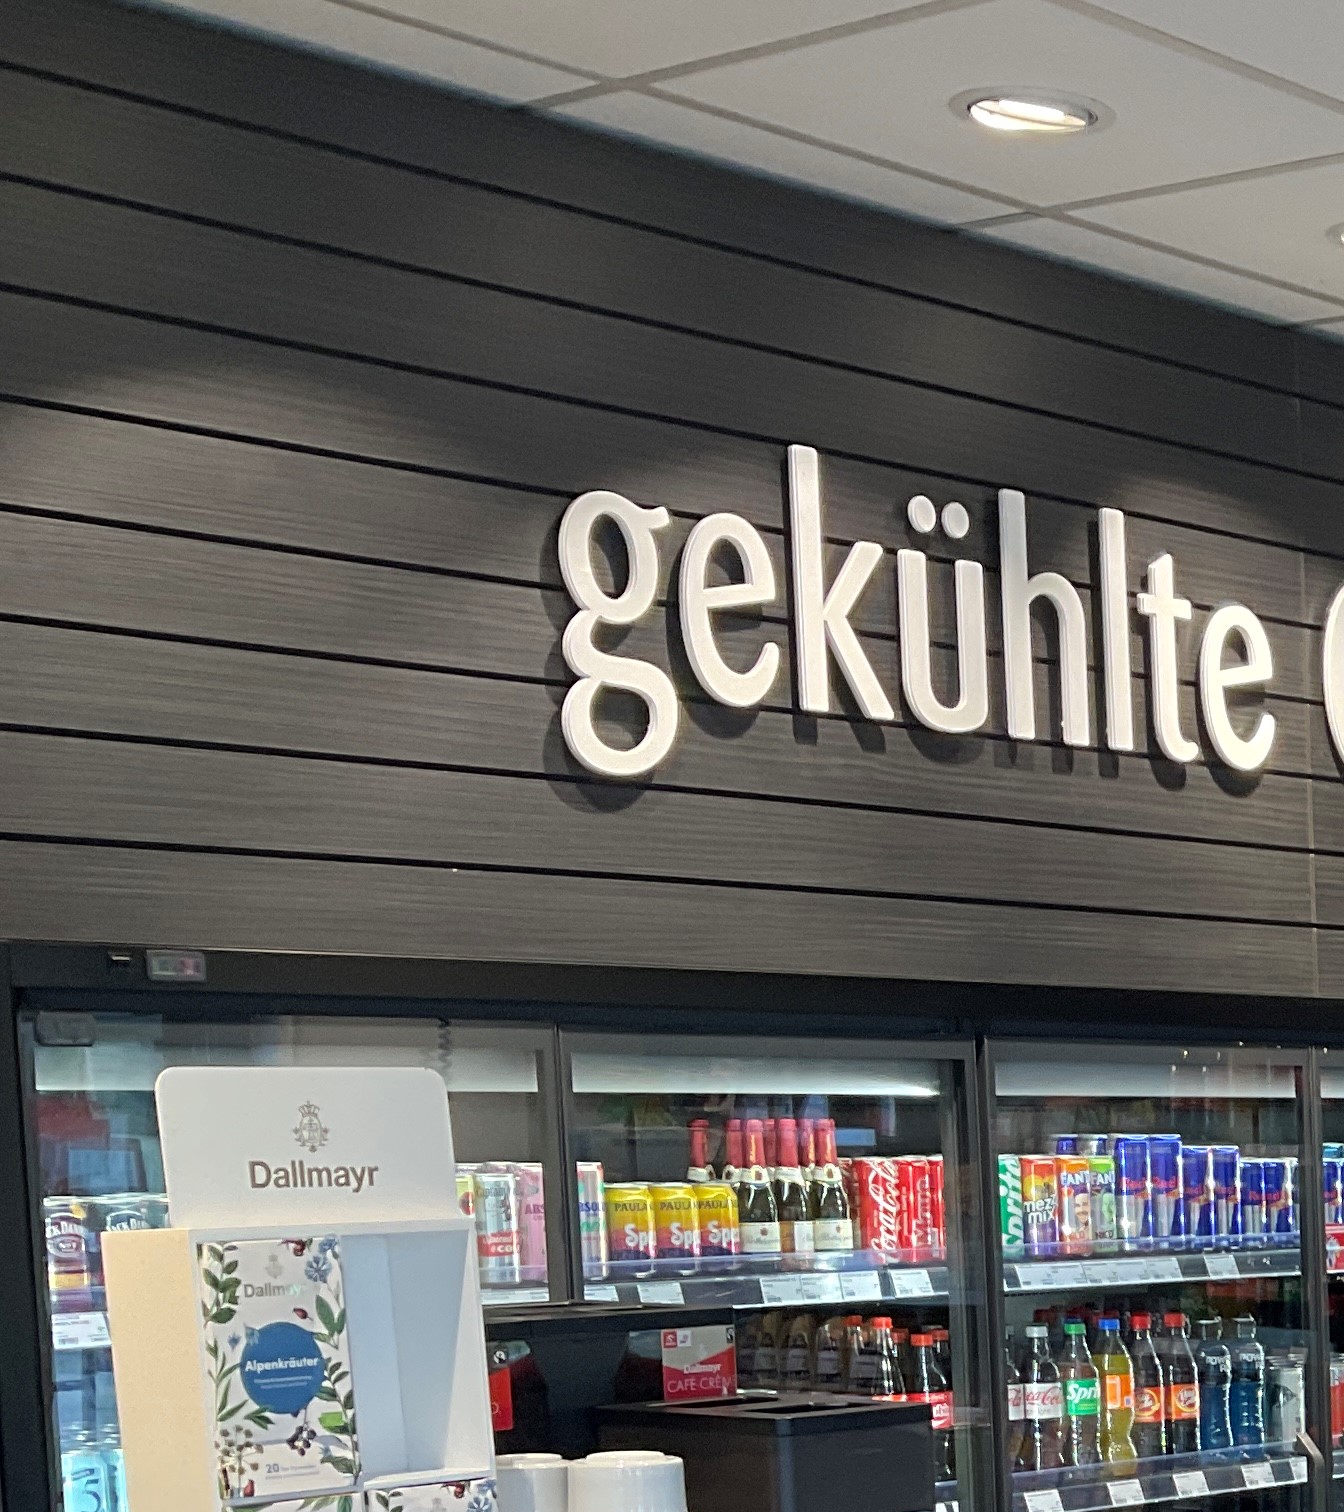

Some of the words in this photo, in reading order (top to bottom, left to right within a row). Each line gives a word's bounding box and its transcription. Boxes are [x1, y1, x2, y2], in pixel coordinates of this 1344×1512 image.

[557, 444, 1277, 777] gekühlte
[248, 1160, 380, 1191] Dallmayr
[1027, 1208, 1054, 1224] mix
[244, 1355, 320, 1375] Alpenkräuter
[667, 1375, 698, 1394] CAFÉ
[265, 1461, 280, 1474] 20
